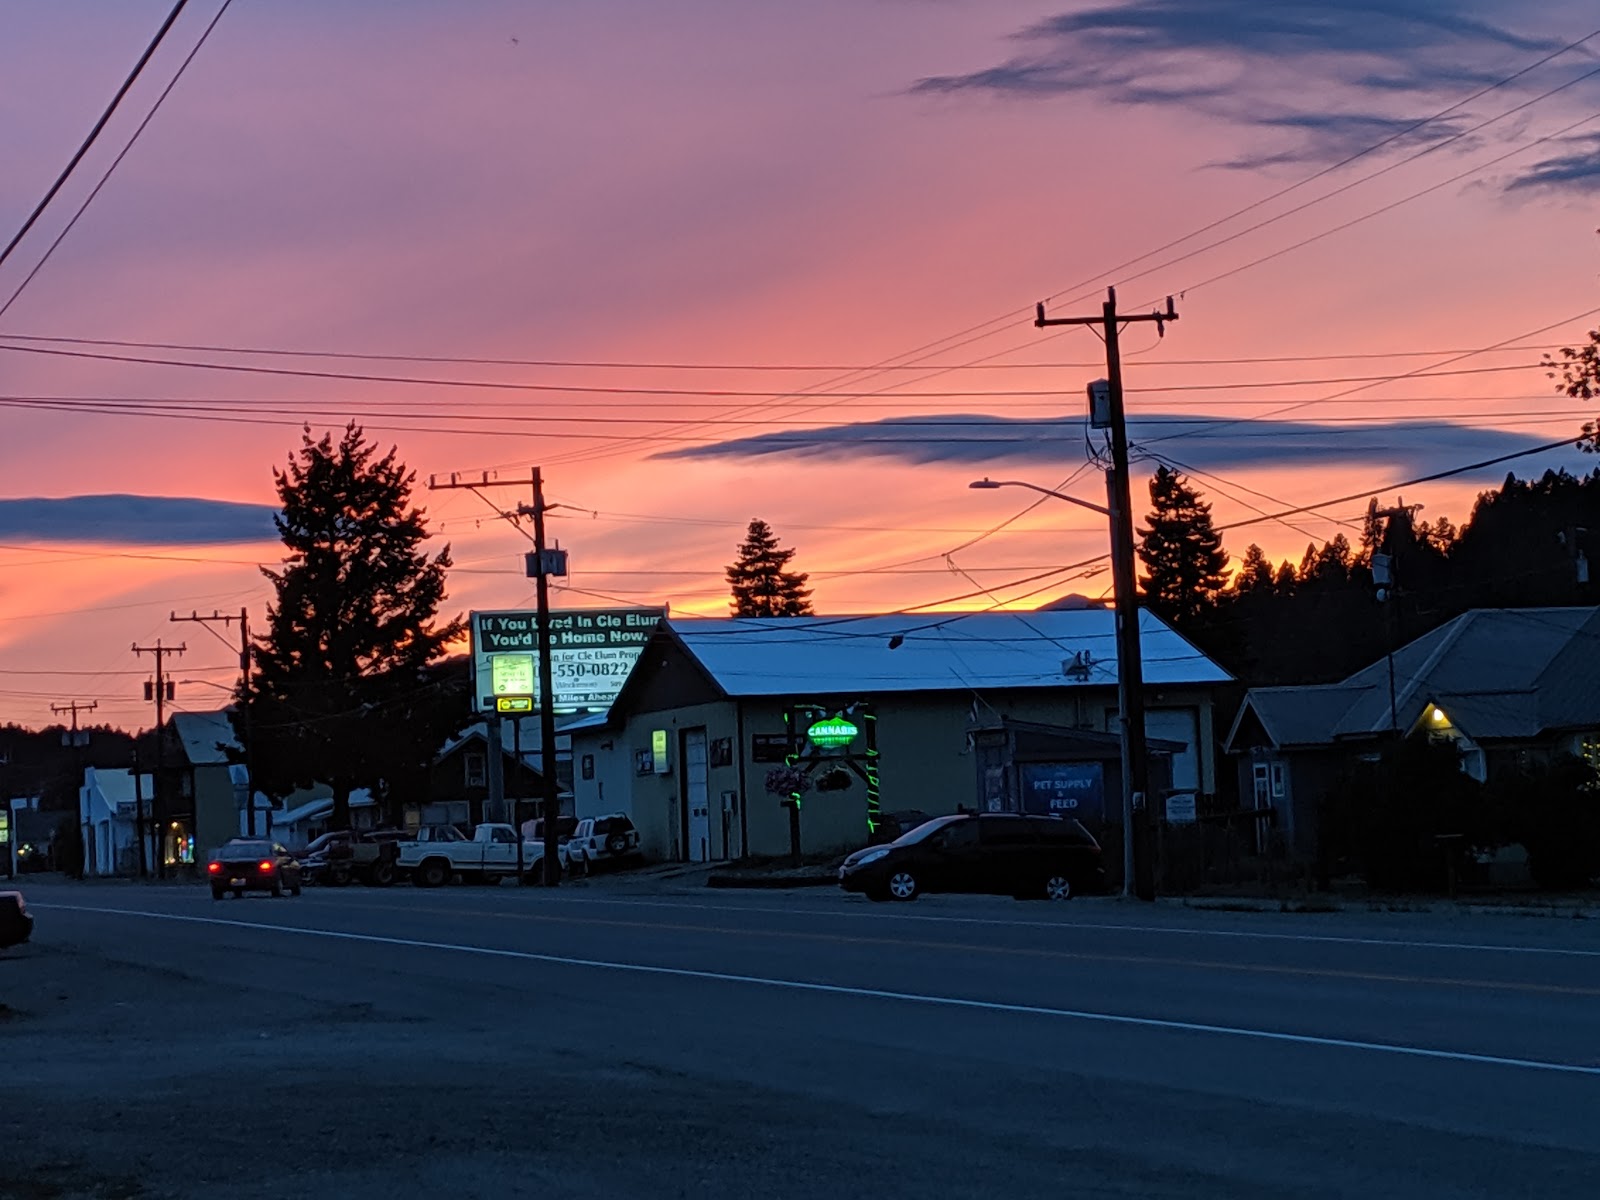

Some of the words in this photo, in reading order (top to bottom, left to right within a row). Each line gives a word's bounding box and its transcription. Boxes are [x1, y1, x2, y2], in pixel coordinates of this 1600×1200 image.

[481, 617, 493, 631] If
[497, 617, 527, 631] You
[530, 615, 573, 630] Lved
[577, 614, 593, 628] In
[596, 614, 622, 627] Cle
[490, 631, 532, 646] You'd
[561, 630, 606, 644] Home
[610, 630, 649, 643] Now.
[577, 651, 592, 661] Cle
[595, 650, 617, 660] Elum
[559, 693, 585, 703] Miles
[807, 725, 858, 737] CANNABIS
[1033, 780, 1053, 790] PET
[1054, 778, 1092, 789] SUPPLY
[1049, 798, 1079, 809] FEED
